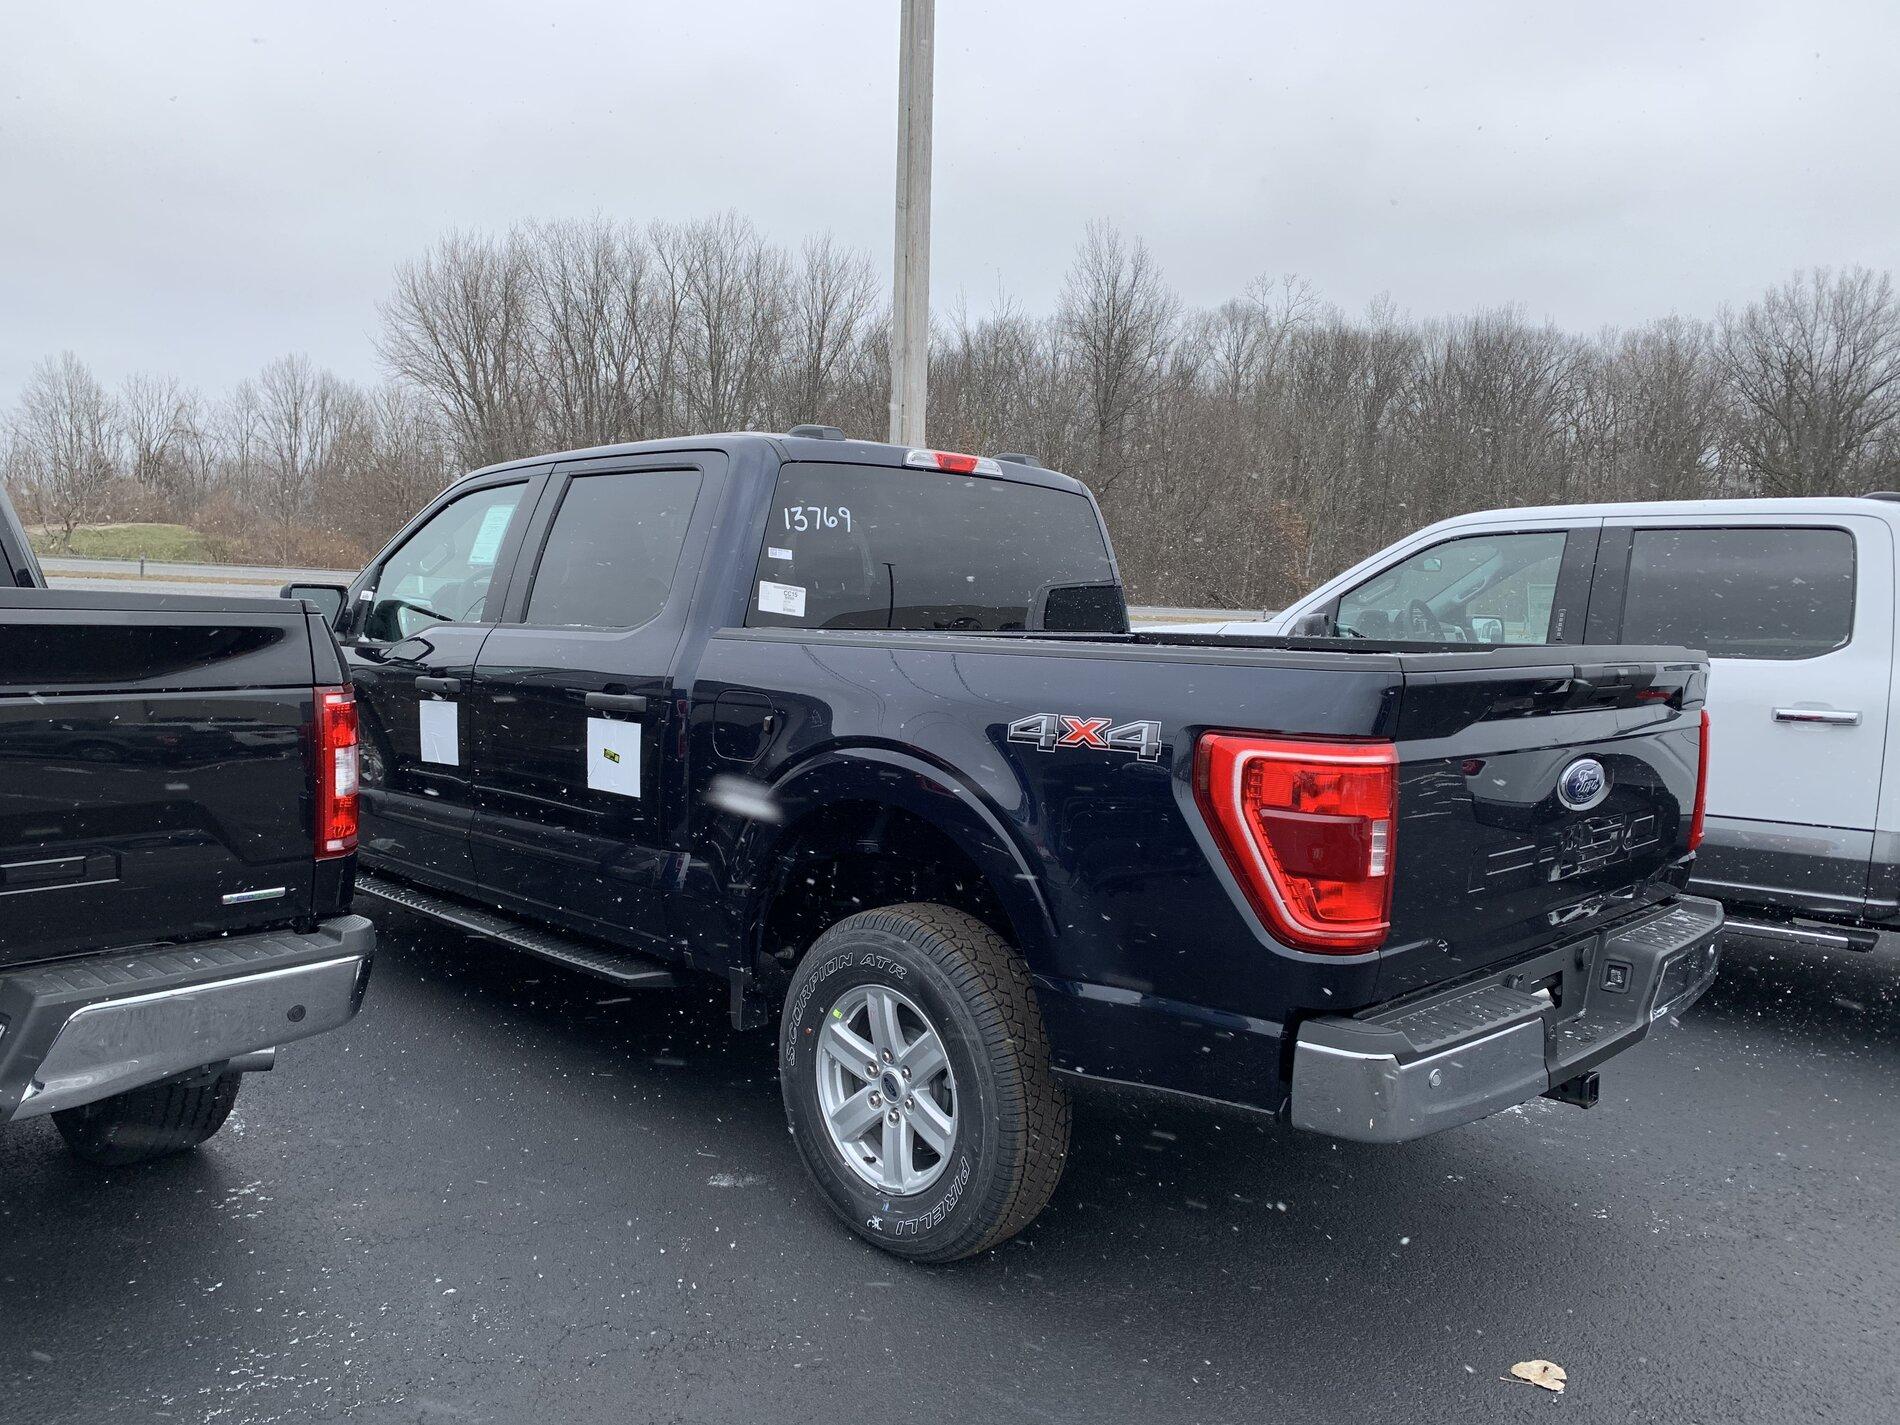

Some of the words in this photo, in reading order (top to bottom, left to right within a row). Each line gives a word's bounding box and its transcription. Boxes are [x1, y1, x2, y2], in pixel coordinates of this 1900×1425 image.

[784, 506, 851, 533] 13769
[1575, 769, 1600, 793] Ford
[786, 952, 854, 1067] SCORPION
[860, 953, 908, 980] ATR
[895, 1156, 971, 1236] PIRELLI
